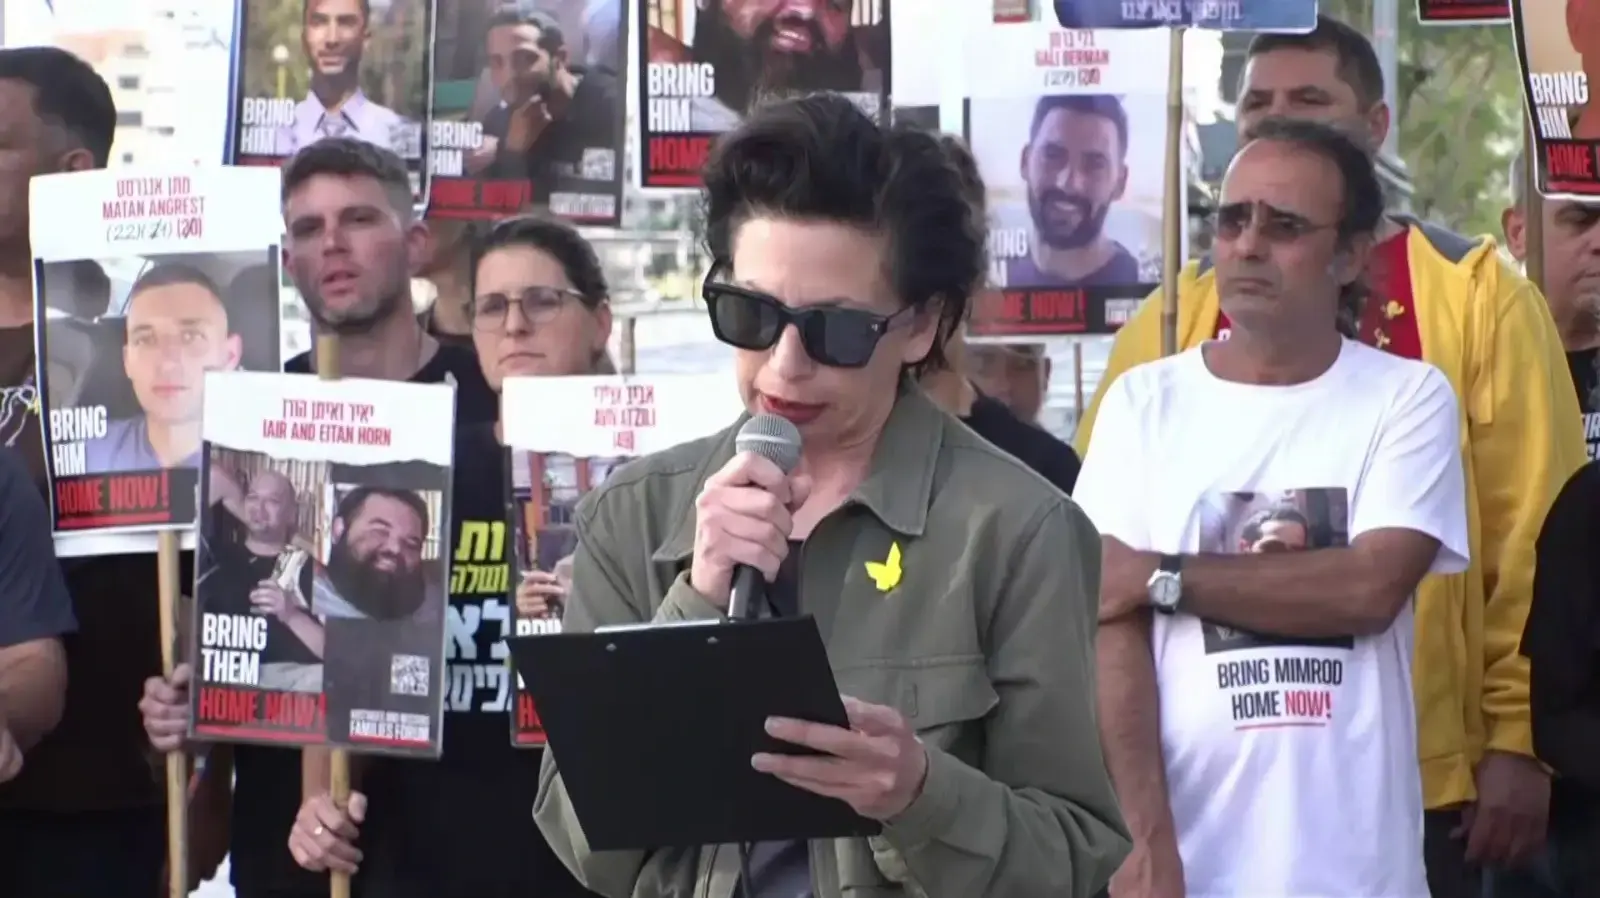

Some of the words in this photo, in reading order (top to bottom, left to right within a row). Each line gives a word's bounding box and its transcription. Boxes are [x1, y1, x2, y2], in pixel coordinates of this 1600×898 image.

[647, 62, 715, 96] BRING
[1529, 71, 1589, 104] BRING
[241, 97, 295, 126] BRING
[648, 98, 692, 132] HIM
[1536, 106, 1573, 139] HIM
[240, 126, 276, 155] HIM
[431, 121, 483, 149] BRING
[431, 149, 463, 177] HIM
[1545, 143, 1593, 178] HOME
[168, 176, 191, 196] מתן
[102, 200, 145, 220] MATAN
[149, 196, 205, 216] ANGREST
[50, 404, 108, 443] BRING
[348, 403, 376, 423] יאיר
[262, 418, 287, 439] IAIR
[290, 421, 316, 442] AND
[319, 423, 354, 444] EITAN
[358, 426, 392, 447] HORN
[52, 440, 87, 478] HIM
[57, 477, 104, 515] HOME
[109, 469, 170, 511] NOW!
[202, 612, 268, 651] BRING
[201, 649, 260, 685] THEM
[1217, 658, 1270, 689] BRING
[1274, 657, 1343, 686] MIMROD
[199, 686, 257, 725] HOME
[266, 691, 327, 731] NOW!
[1231, 690, 1281, 721] HOME
[1284, 689, 1332, 720] NOW!
